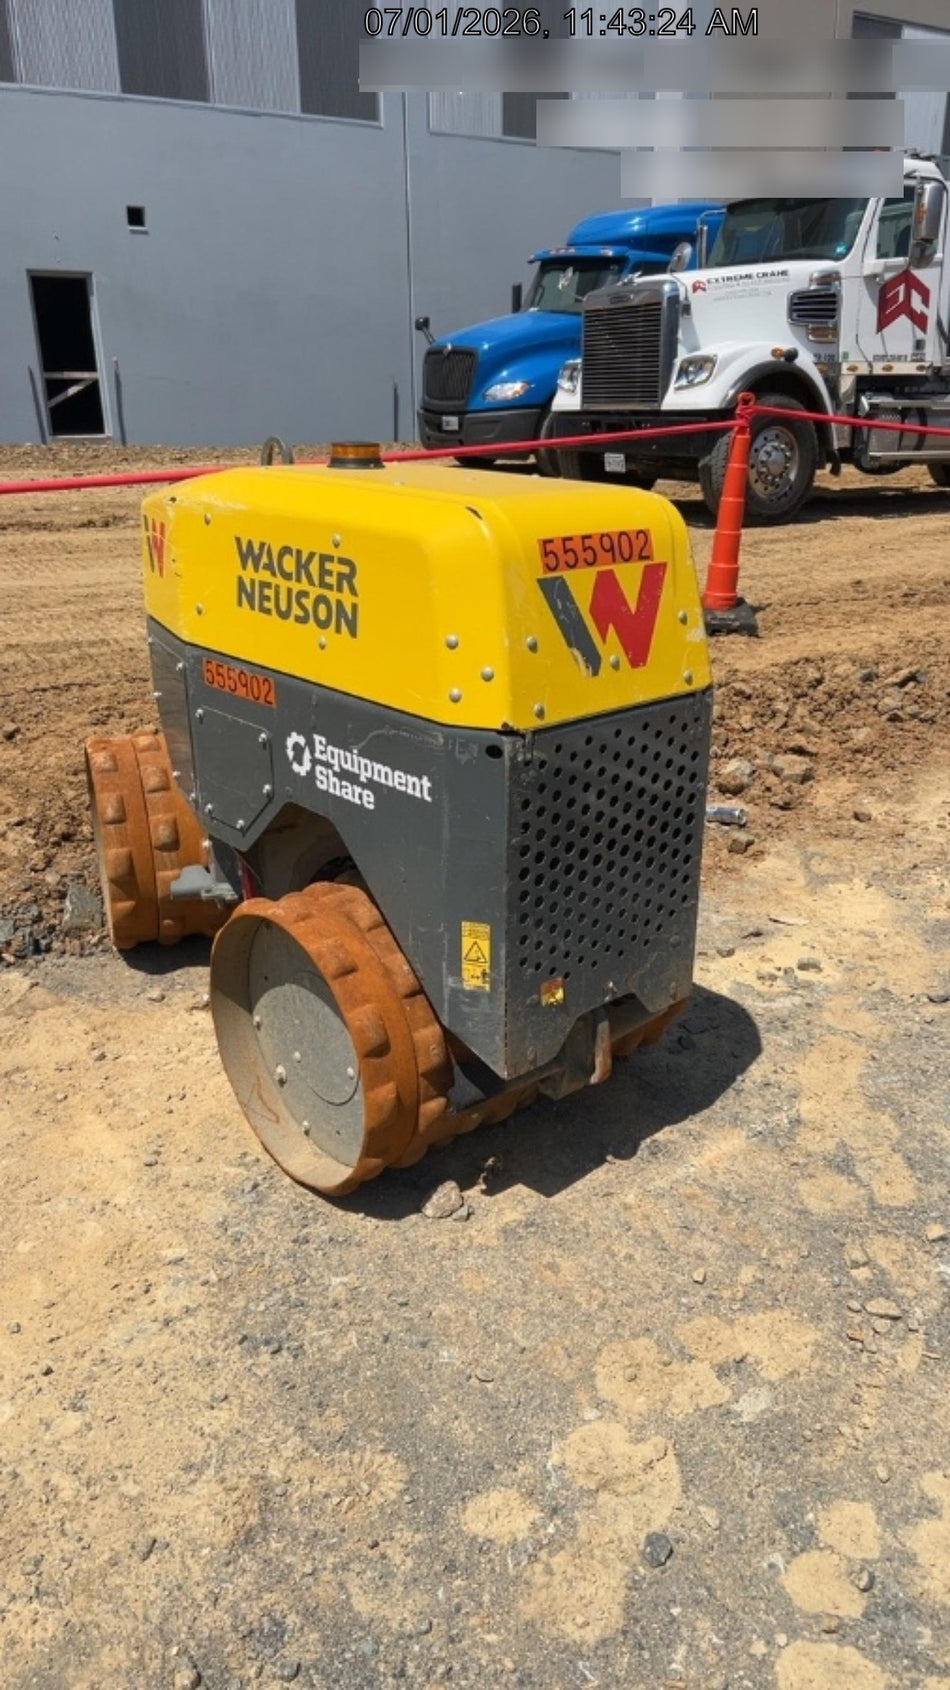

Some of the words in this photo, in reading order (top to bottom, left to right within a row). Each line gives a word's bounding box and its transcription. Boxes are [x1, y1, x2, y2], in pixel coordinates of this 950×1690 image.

[706, 273, 753, 285] EXTREME
[234, 536, 359, 597] WACKER
[542, 529, 652, 573] 555902
[236, 574, 359, 639] NEUSON
[204, 660, 273, 706] 555902
[313, 734, 433, 803] Equipment
[315, 765, 376, 810] Share
